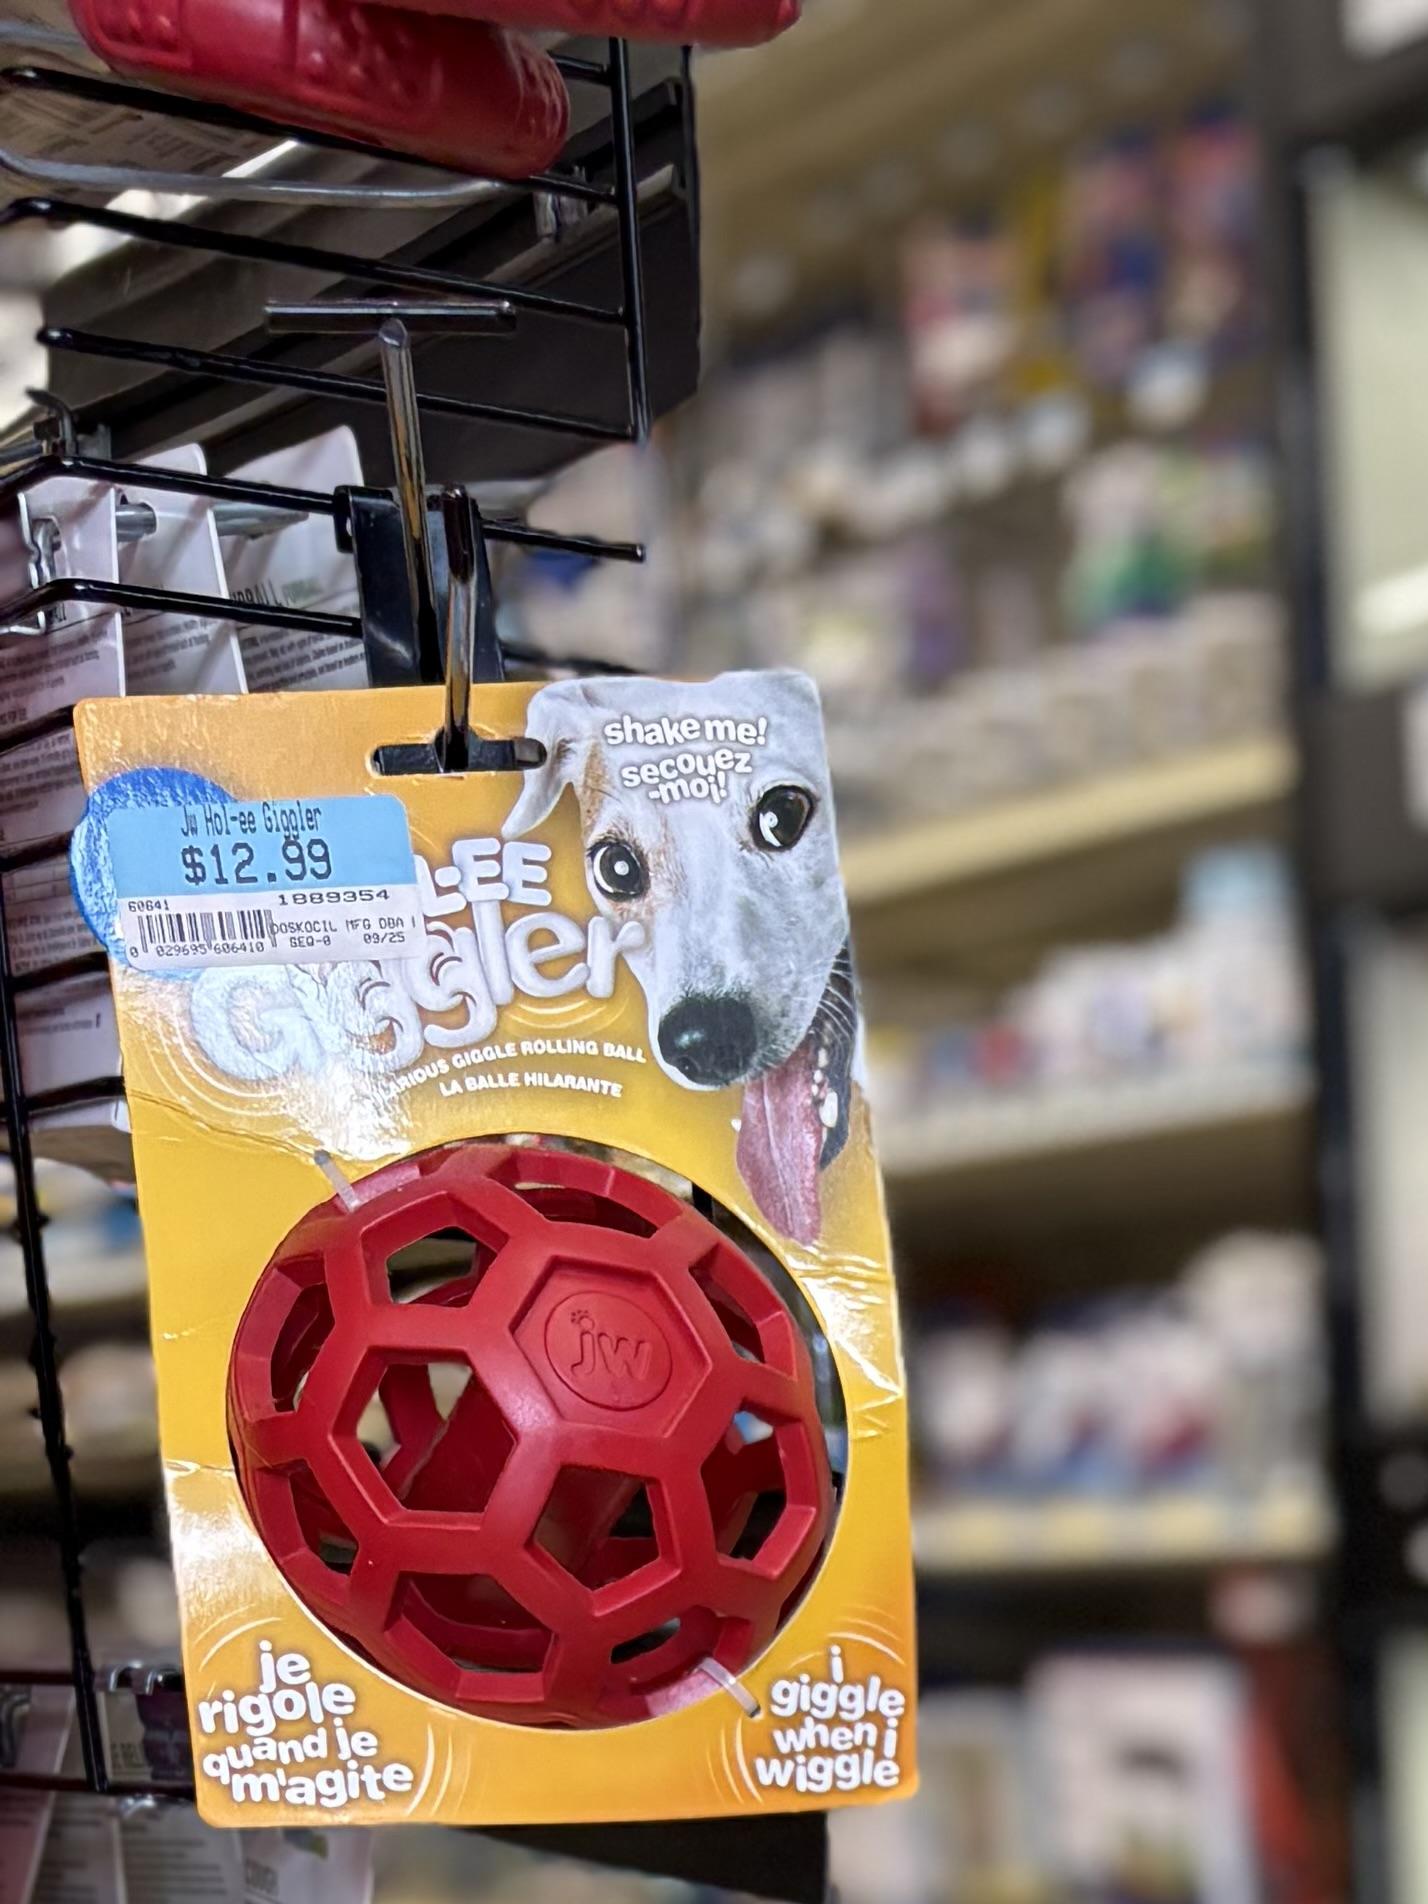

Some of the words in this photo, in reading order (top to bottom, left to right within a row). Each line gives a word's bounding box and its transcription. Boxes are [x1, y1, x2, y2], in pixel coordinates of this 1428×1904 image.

[604, 715, 700, 746] shake
[705, 717, 767, 745] me!
[621, 748, 752, 787] secouez
[648, 771, 727, 804] -moi!
[203, 801, 257, 836] Hol-ee
[262, 800, 322, 840] Giggler
[181, 838, 332, 886] $12.99
[414, 838, 552, 917] L-EE
[278, 889, 390, 906] 1889354
[451, 1042, 518, 1069] GIGGLE
[520, 1039, 599, 1055] ROLLING
[603, 1042, 647, 1063] BALL
[438, 1079, 463, 1098] LA
[466, 1072, 520, 1092] BALLE
[523, 1072, 623, 1098] HILARANTE
[258, 1640, 311, 1693] je
[830, 1645, 844, 1683] i
[198, 1681, 356, 1737] rigole
[770, 1673, 906, 1721] giggle
[202, 1727, 327, 1785] quand
[333, 1717, 378, 1761] je
[772, 1716, 878, 1754] when
[884, 1717, 898, 1759] i
[231, 1759, 414, 1808] m'agite
[755, 1748, 900, 1793] wiggle
